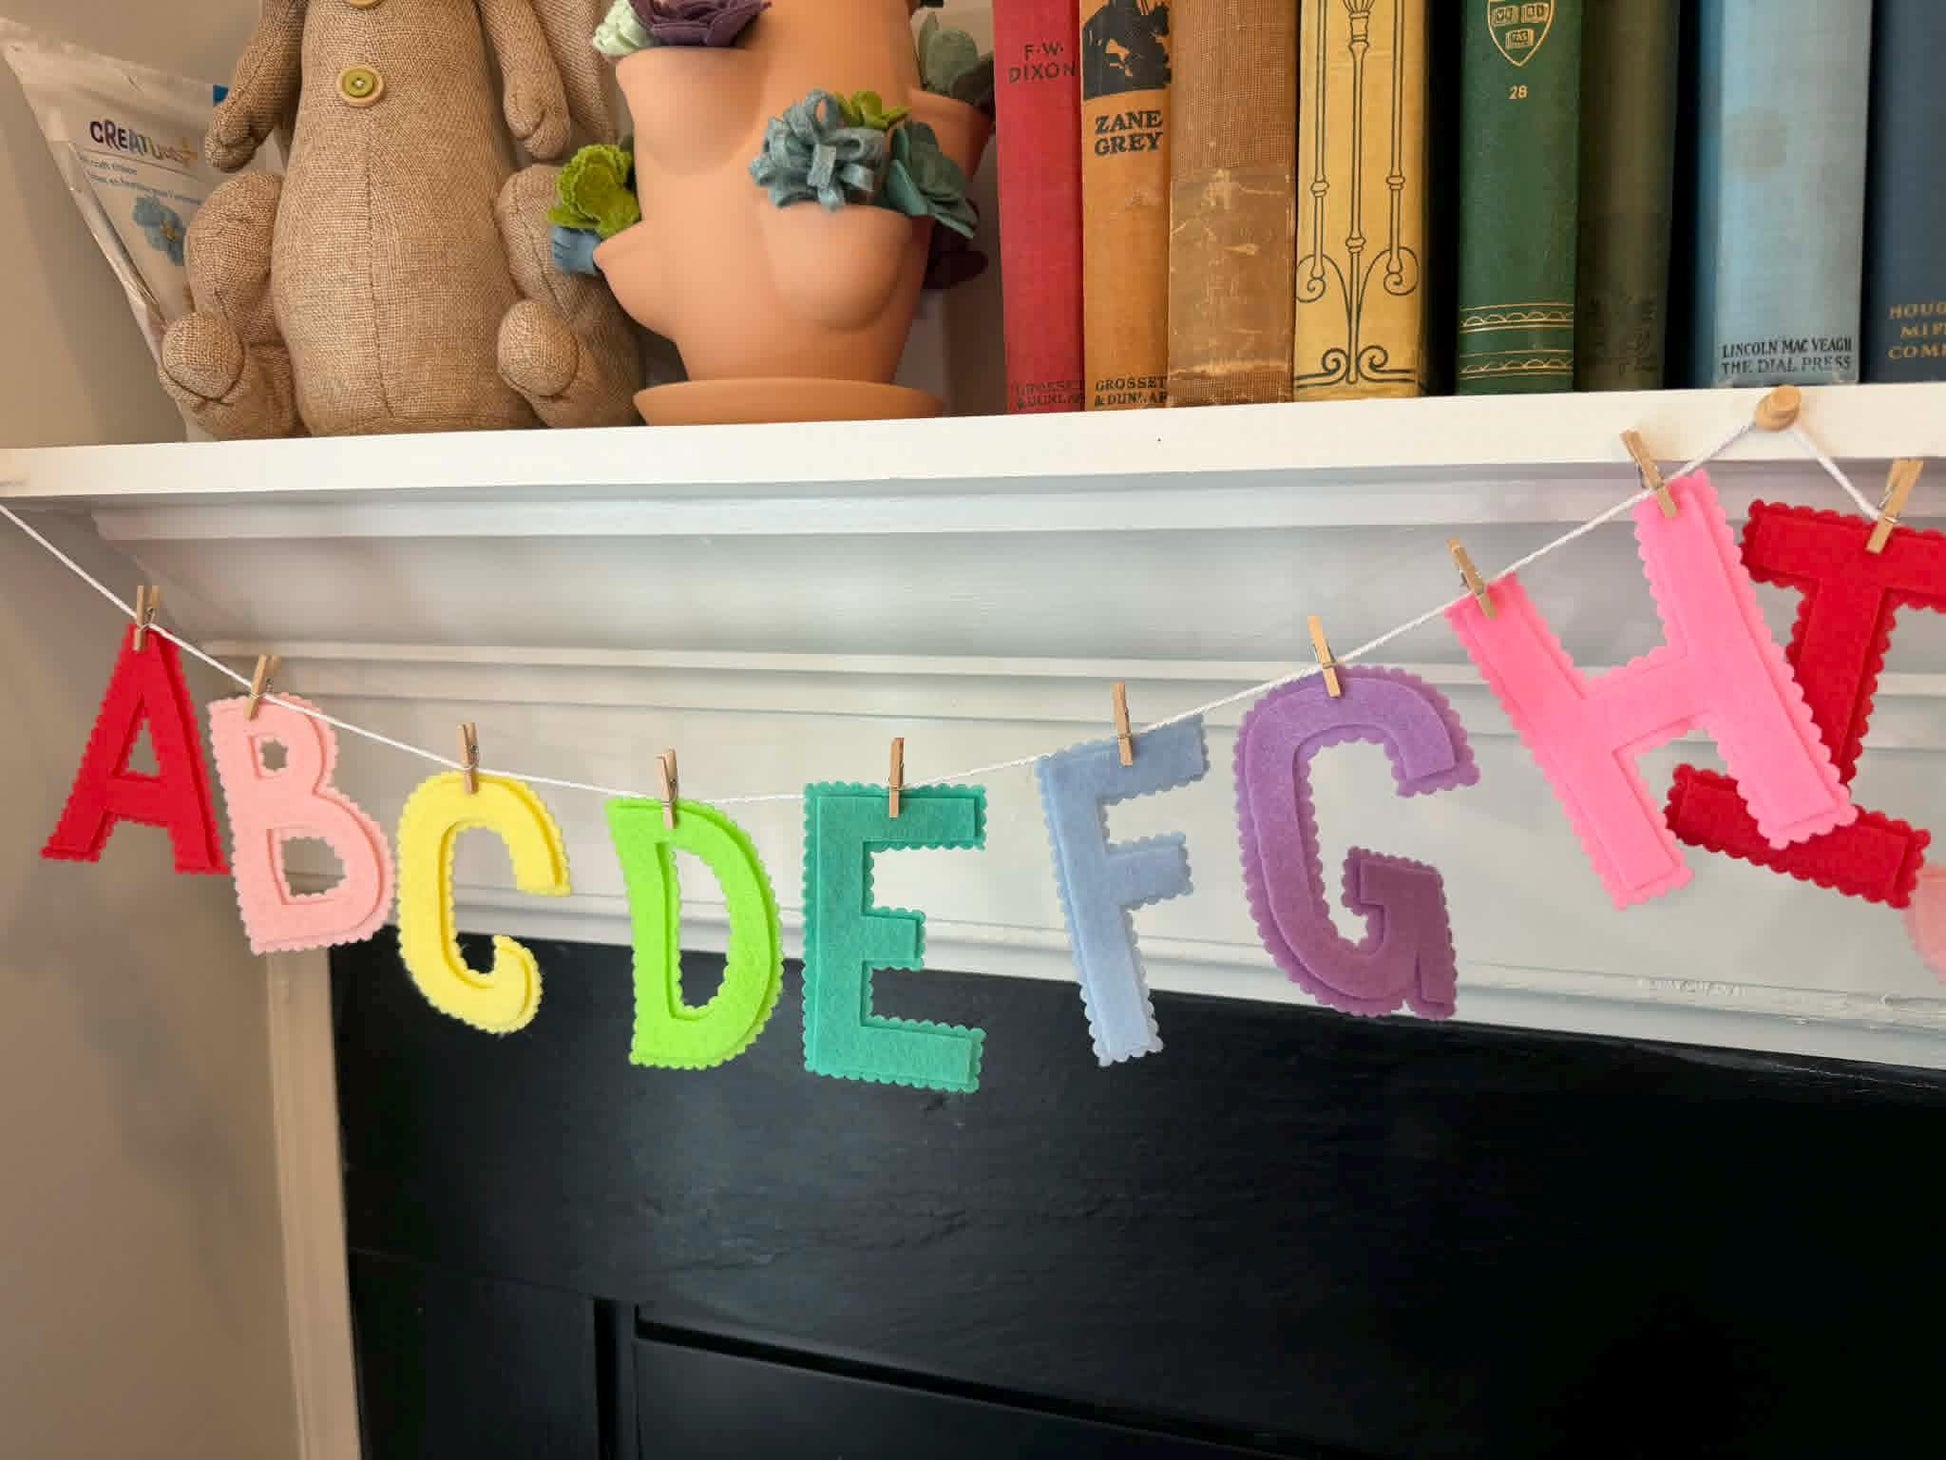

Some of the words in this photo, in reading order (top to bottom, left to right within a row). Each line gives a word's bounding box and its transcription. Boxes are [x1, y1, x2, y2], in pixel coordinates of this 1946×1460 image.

[1008, 64, 1076, 84] DIXON
[1509, 85, 1528, 100] 28
[1095, 110, 1163, 135] ZANE
[1094, 132, 1163, 157] GREY
[1722, 341, 1778, 358] LINCOLN
[1811, 337, 1852, 352] VEAGH
[1721, 361, 1752, 374] THE
[1757, 358, 1796, 373] DIAL
[1801, 356, 1850, 371] PRESS
[1095, 376, 1168, 391] GROSSET
[41, 620, 230, 876] A
[207, 690, 394, 955] B
[397, 769, 572, 1036] C
[607, 797, 784, 1070] D
[803, 781, 986, 1093] E
[1035, 712, 1210, 1067] F
[1233, 664, 1480, 1021] G
[1444, 468, 1859, 910] H
[1662, 500, 1946, 909] I
